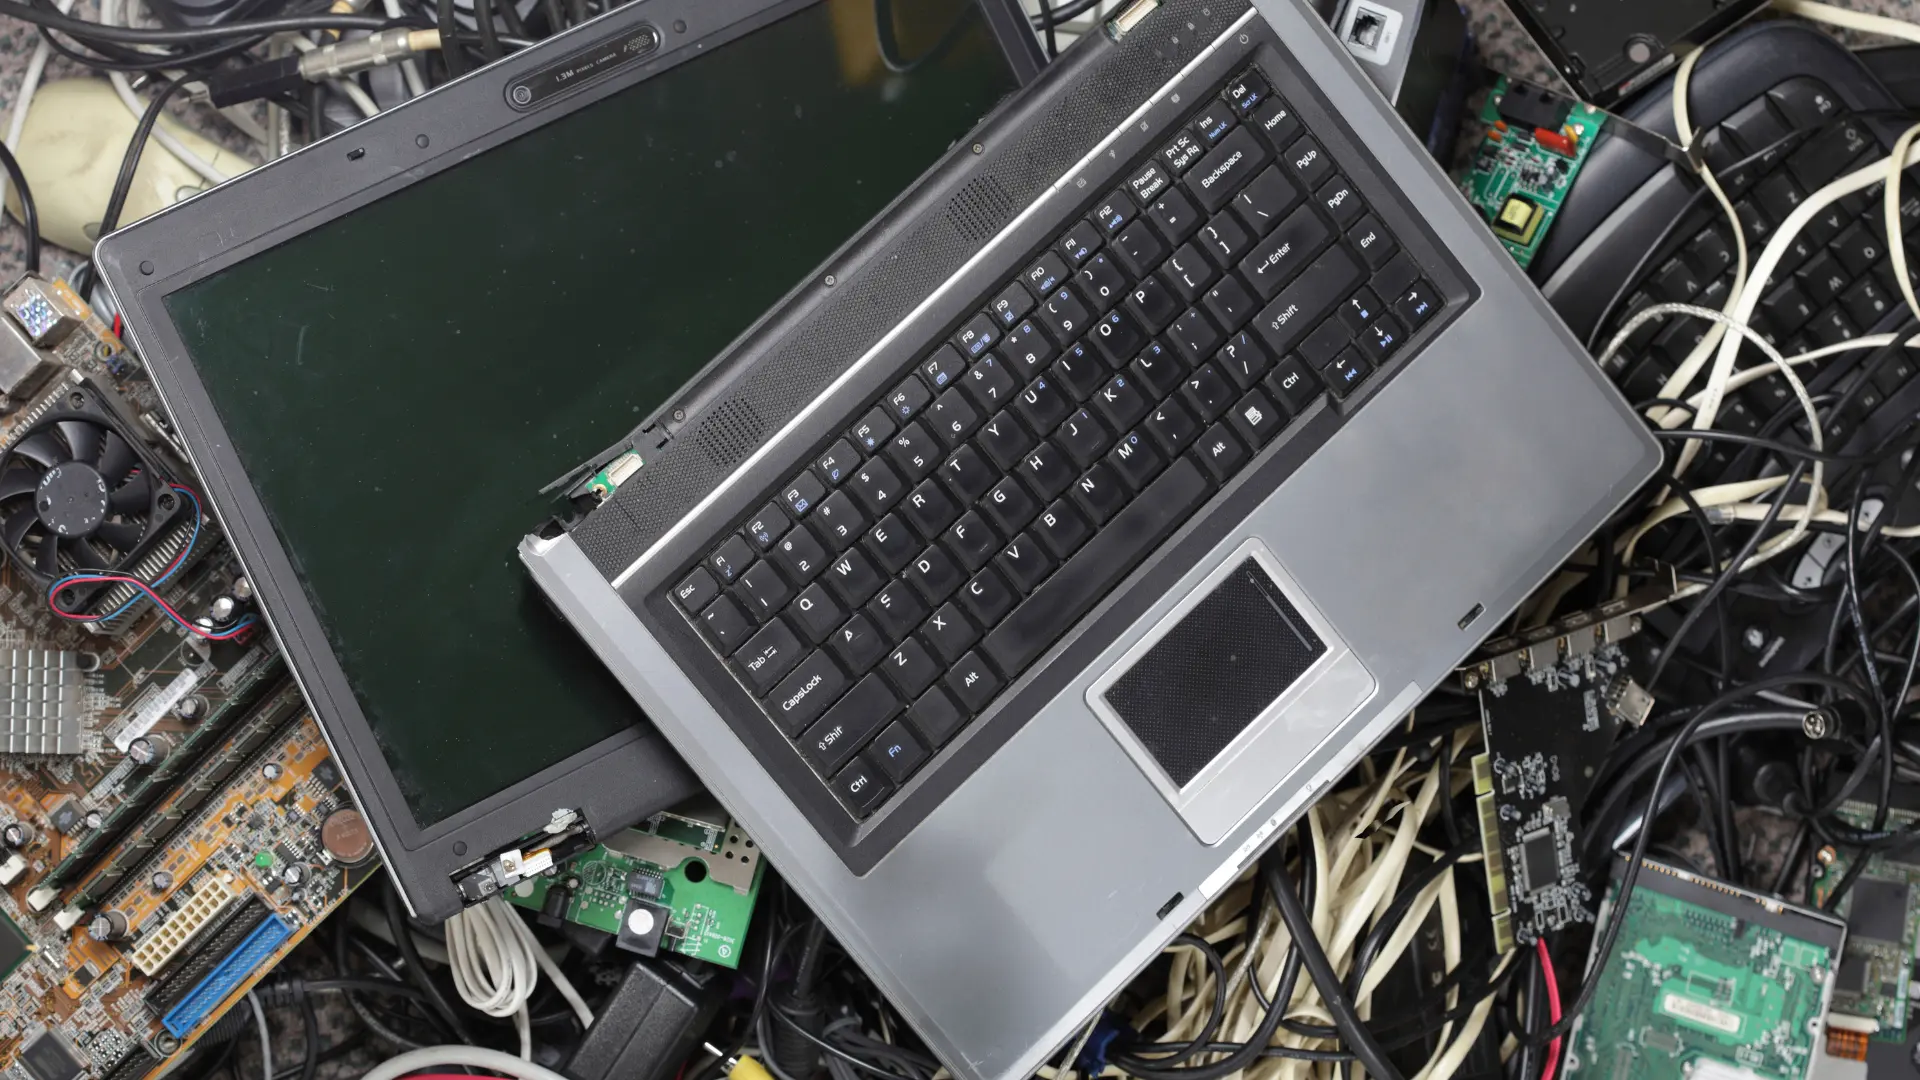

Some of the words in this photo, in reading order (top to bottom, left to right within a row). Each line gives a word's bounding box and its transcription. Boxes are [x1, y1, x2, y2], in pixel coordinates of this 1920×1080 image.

[1232, 84, 1246, 98] Del
[1200, 117, 1212, 128] Ins
[1265, 110, 1286, 130] Home
[1208, 128, 1220, 139] Num
[1166, 144, 1179, 159] Prt
[1177, 135, 1190, 147] Sc
[1173, 154, 1188, 169] Sys
[1186, 144, 1200, 158] Rq
[1297, 151, 1316, 168] PgUp
[1202, 152, 1242, 188] Backspace
[1133, 168, 1156, 189] Pause
[1140, 178, 1163, 198] Break
[1328, 190, 1348, 208] PgDn
[1788, 192, 1799, 205] Z
[1100, 206, 1112, 219] F12
[1752, 221, 1766, 233] X
[1828, 215, 1839, 228] A
[1066, 238, 1076, 250] F11
[1361, 232, 1376, 248] End
[1269, 243, 1290, 264] Enter
[1720, 250, 1730, 263] C
[1031, 267, 1044, 280] F10
[1686, 279, 1698, 293] V
[1829, 276, 1844, 290] W
[1061, 292, 1068, 300] 9
[1136, 291, 1144, 303] P
[997, 300, 1008, 311] F9
[1277, 305, 1298, 324] Shift
[1023, 325, 1031, 333] 8
[1064, 320, 1072, 331] 9
[1100, 324, 1111, 336] O
[963, 331, 974, 343] F8
[1075, 348, 1083, 356] 5
[1153, 346, 1160, 354] 3
[1227, 345, 1235, 357] ?
[985, 358, 993, 367] 7
[1026, 353, 1035, 363] 8
[1141, 359, 1152, 367] L
[928, 362, 937, 374] F7
[974, 371, 983, 379] &
[1283, 372, 1299, 388] Ctrl
[1038, 381, 1046, 390] 4
[1117, 379, 1124, 387] 2
[989, 387, 996, 398] 7
[1025, 391, 1037, 403] U
[1104, 388, 1117, 402] K
[894, 393, 905, 405] F6
[858, 425, 869, 437] F5
[952, 421, 961, 431] 6
[988, 424, 999, 435] Y
[1070, 423, 1077, 436] J
[899, 437, 910, 447] %
[1118, 443, 1132, 459] M
[1213, 442, 1225, 456] Alt
[823, 457, 834, 469] F4
[914, 456, 923, 467] 5
[950, 459, 960, 471] T
[1030, 456, 1043, 470] H
[861, 473, 869, 482] $
[1082, 478, 1094, 492] N
[788, 489, 799, 501] F3
[879, 490, 886, 500] 4
[912, 494, 925, 507] R
[994, 490, 1006, 502] G
[823, 506, 831, 516] #
[1044, 514, 1056, 527] B
[752, 521, 764, 533] F2
[837, 525, 847, 536] 3
[956, 525, 965, 538] F
[876, 529, 887, 542] E
[784, 542, 792, 550] @
[1007, 546, 1019, 558] V
[716, 556, 725, 566] F1
[799, 561, 810, 571] 2
[918, 560, 930, 573] D
[837, 560, 851, 575] W
[680, 585, 695, 598] Esc
[971, 582, 983, 594] C
[800, 599, 813, 610] Q
[881, 594, 890, 608] S
[933, 616, 946, 630] X
[748, 657, 765, 670] Tab
[894, 652, 907, 666] Z
[966, 672, 978, 687] Alt
[783, 675, 822, 710] CapsLock
[889, 745, 901, 757] Fn
[851, 776, 867, 792] Ctrl
